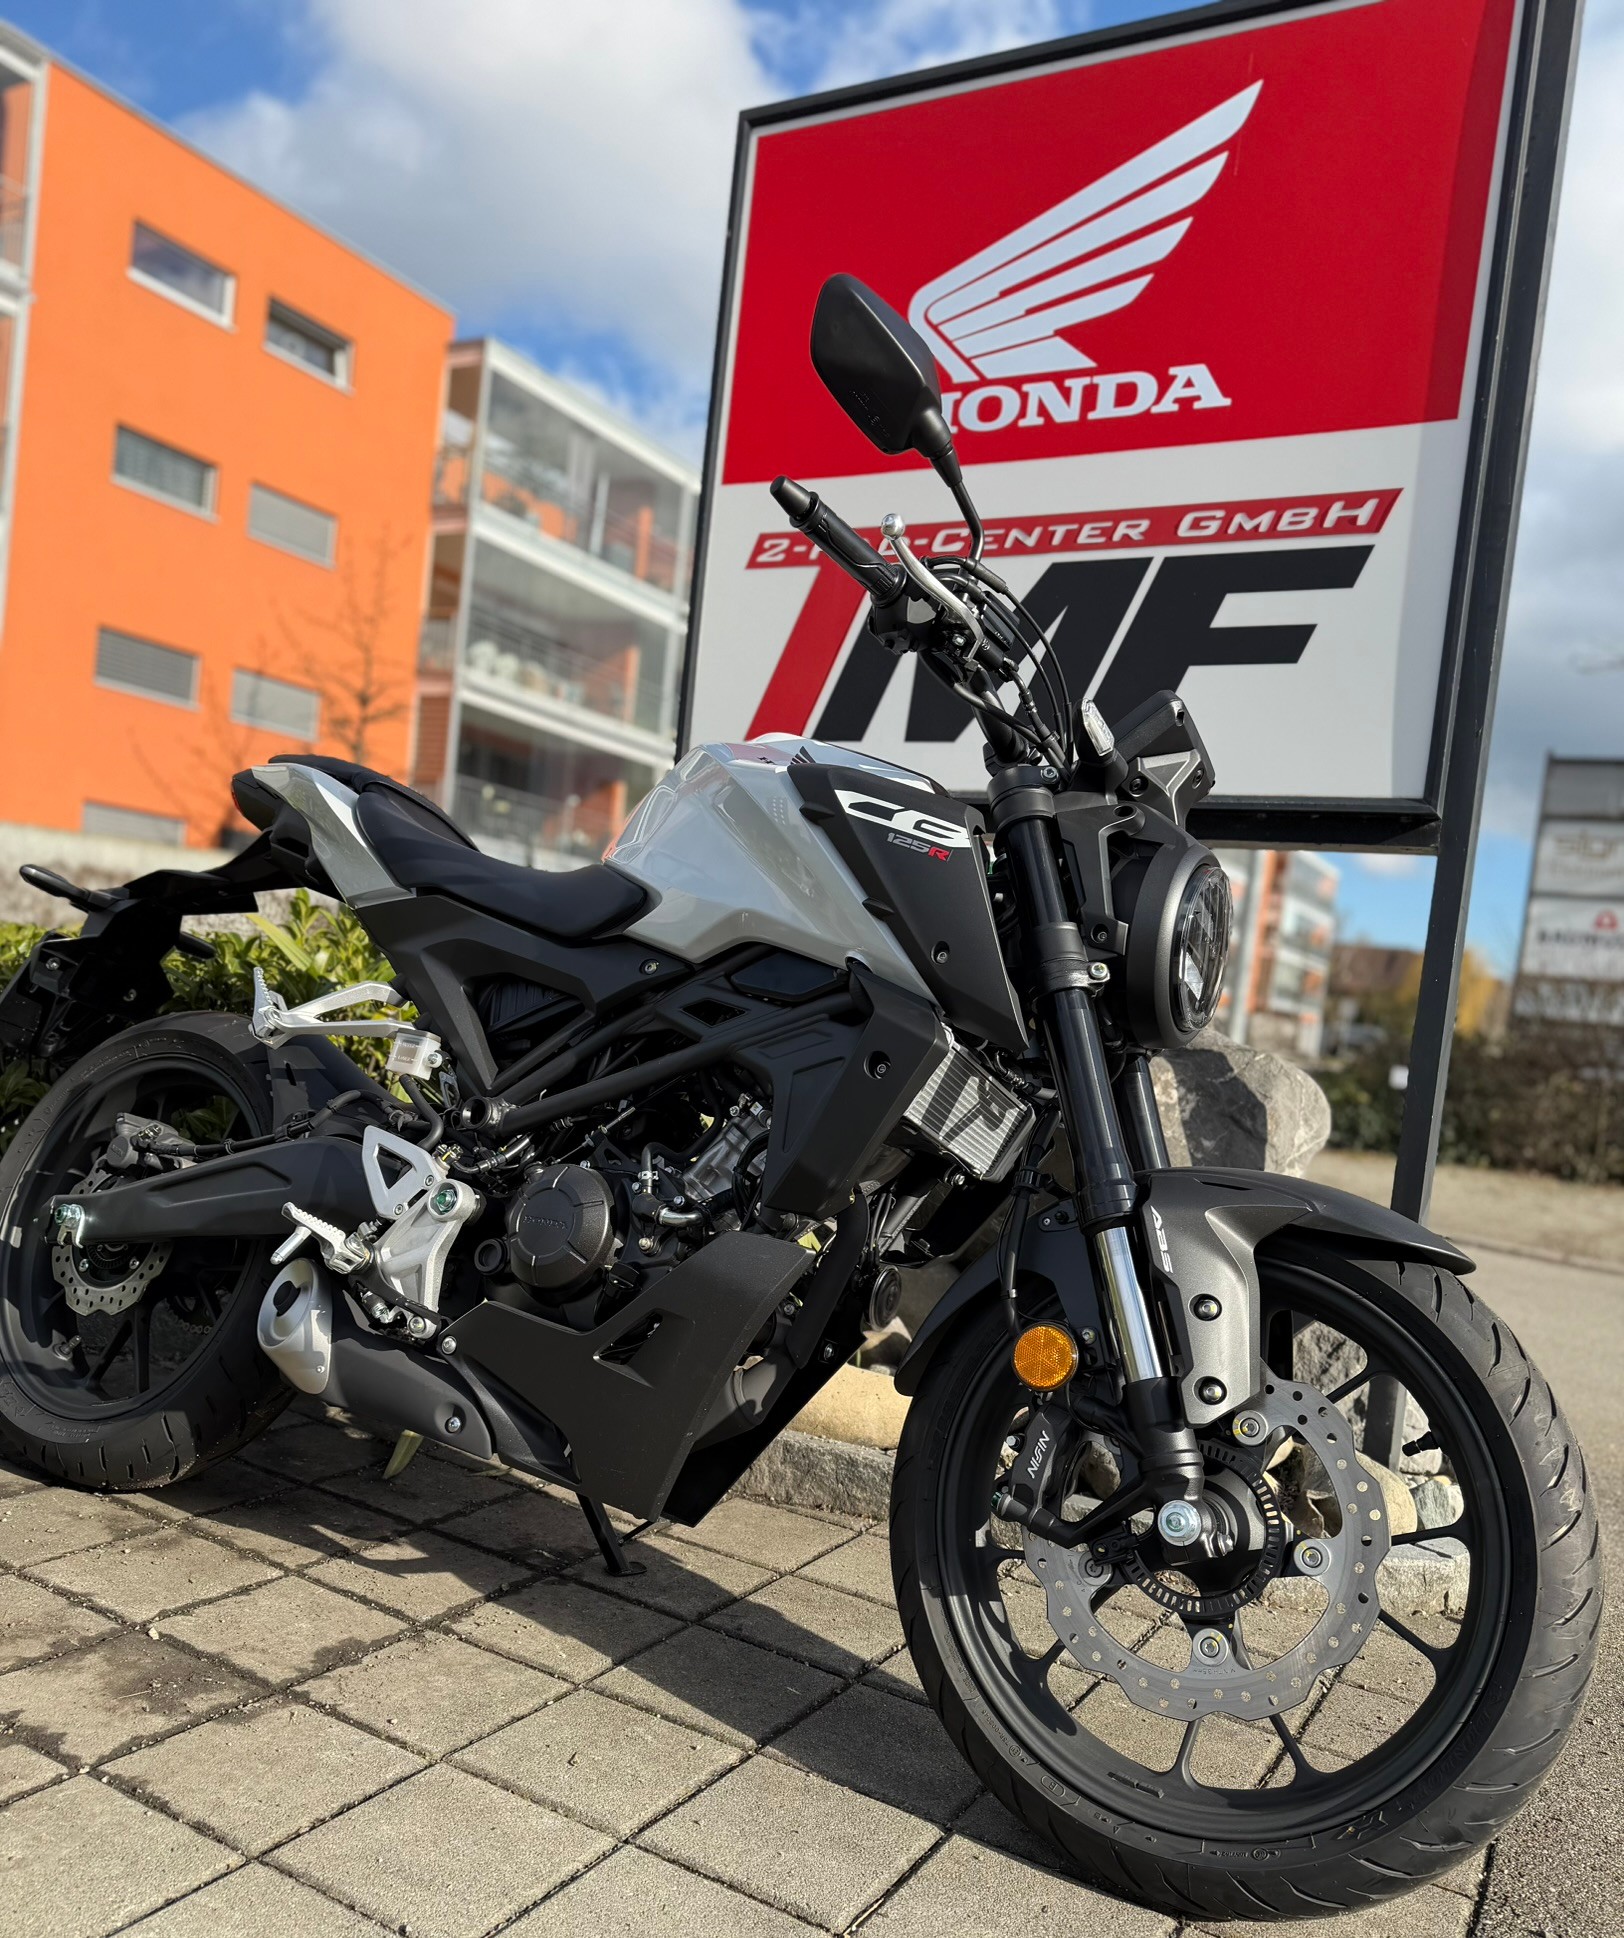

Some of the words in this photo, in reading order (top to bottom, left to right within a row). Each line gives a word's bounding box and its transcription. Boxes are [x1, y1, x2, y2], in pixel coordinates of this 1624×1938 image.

[834, 789, 972, 848] CB
[886, 832, 950, 862] 125R
[1150, 1205, 1174, 1274] ABS
